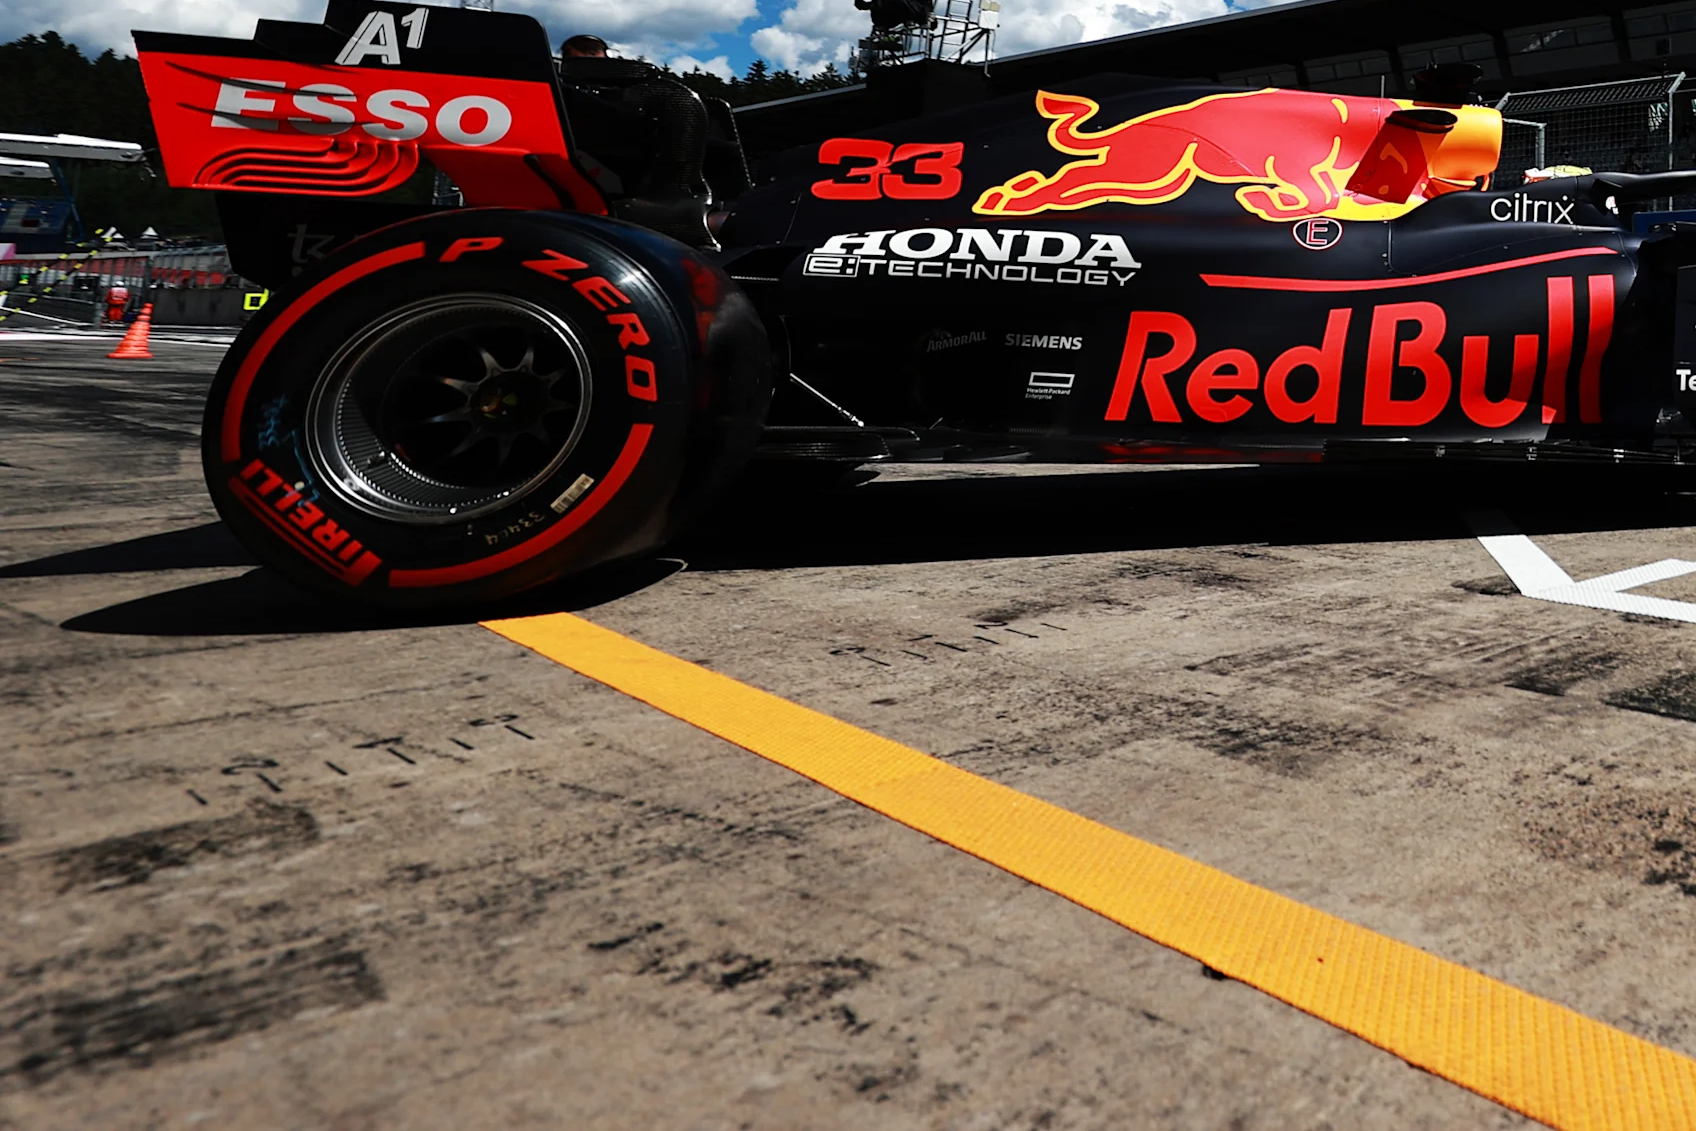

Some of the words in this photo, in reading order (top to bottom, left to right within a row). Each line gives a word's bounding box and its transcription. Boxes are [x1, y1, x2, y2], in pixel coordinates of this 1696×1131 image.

[334, 7, 430, 66] A1
[210, 78, 513, 147] ESSO
[810, 137, 966, 201] 33
[1304, 220, 1330, 245] E
[1489, 192, 1576, 225] citrix
[813, 227, 1142, 269] HONDA
[438, 236, 505, 264] P
[519, 247, 659, 403] ZERO
[1004, 333, 1084, 351] SIEMENS
[1103, 306, 1354, 425] Red
[1360, 273, 1617, 429] Bull
[227, 457, 384, 588] PIRELLI
